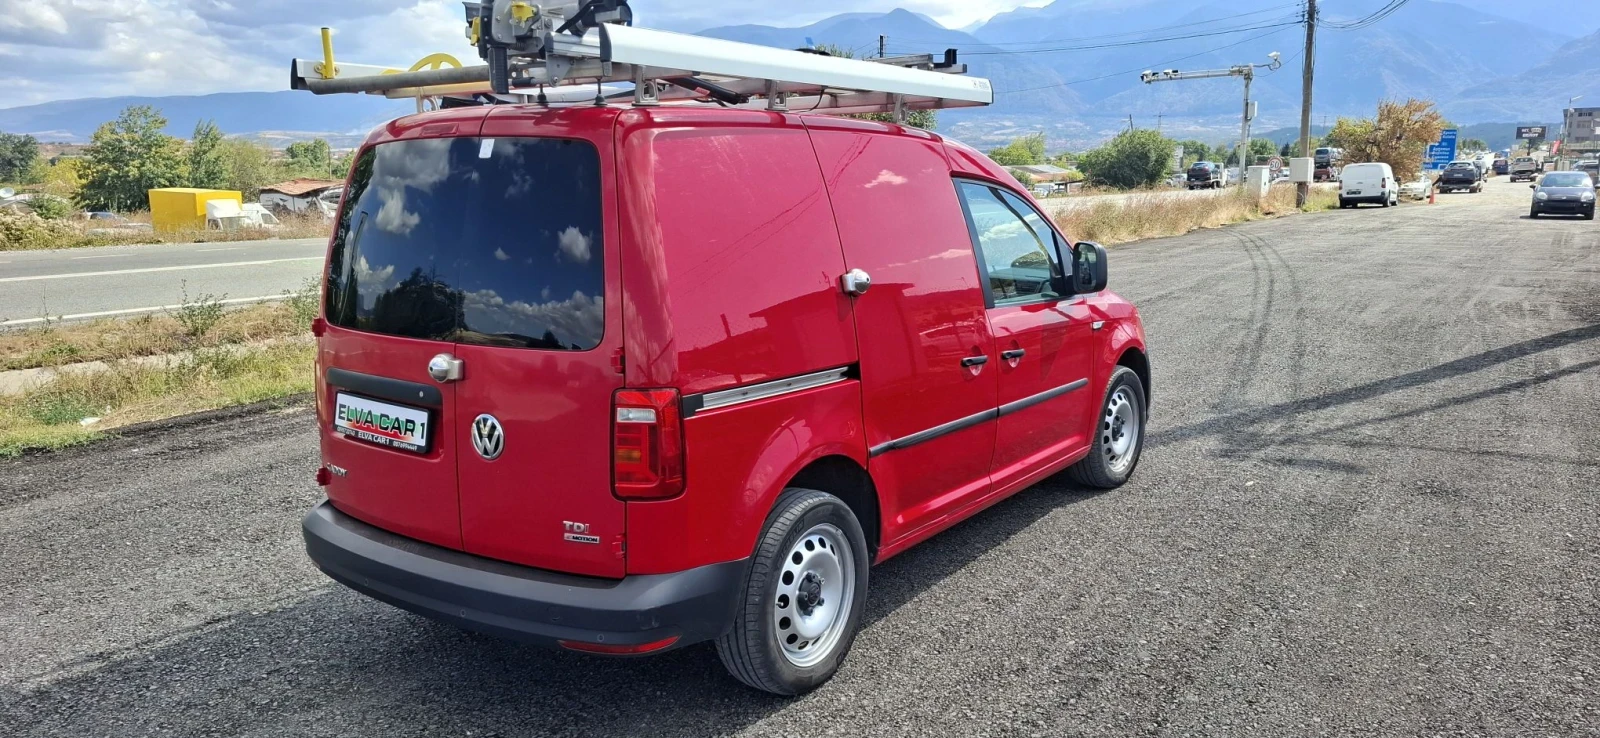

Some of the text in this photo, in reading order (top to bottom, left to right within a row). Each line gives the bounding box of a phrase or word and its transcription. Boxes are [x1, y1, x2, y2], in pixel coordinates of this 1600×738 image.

[338, 403, 375, 429] ELVA
[380, 412, 416, 437] CAR
[420, 422, 426, 440] 1
[358, 431, 373, 441] ELVA
[562, 521, 589, 533] TDI
